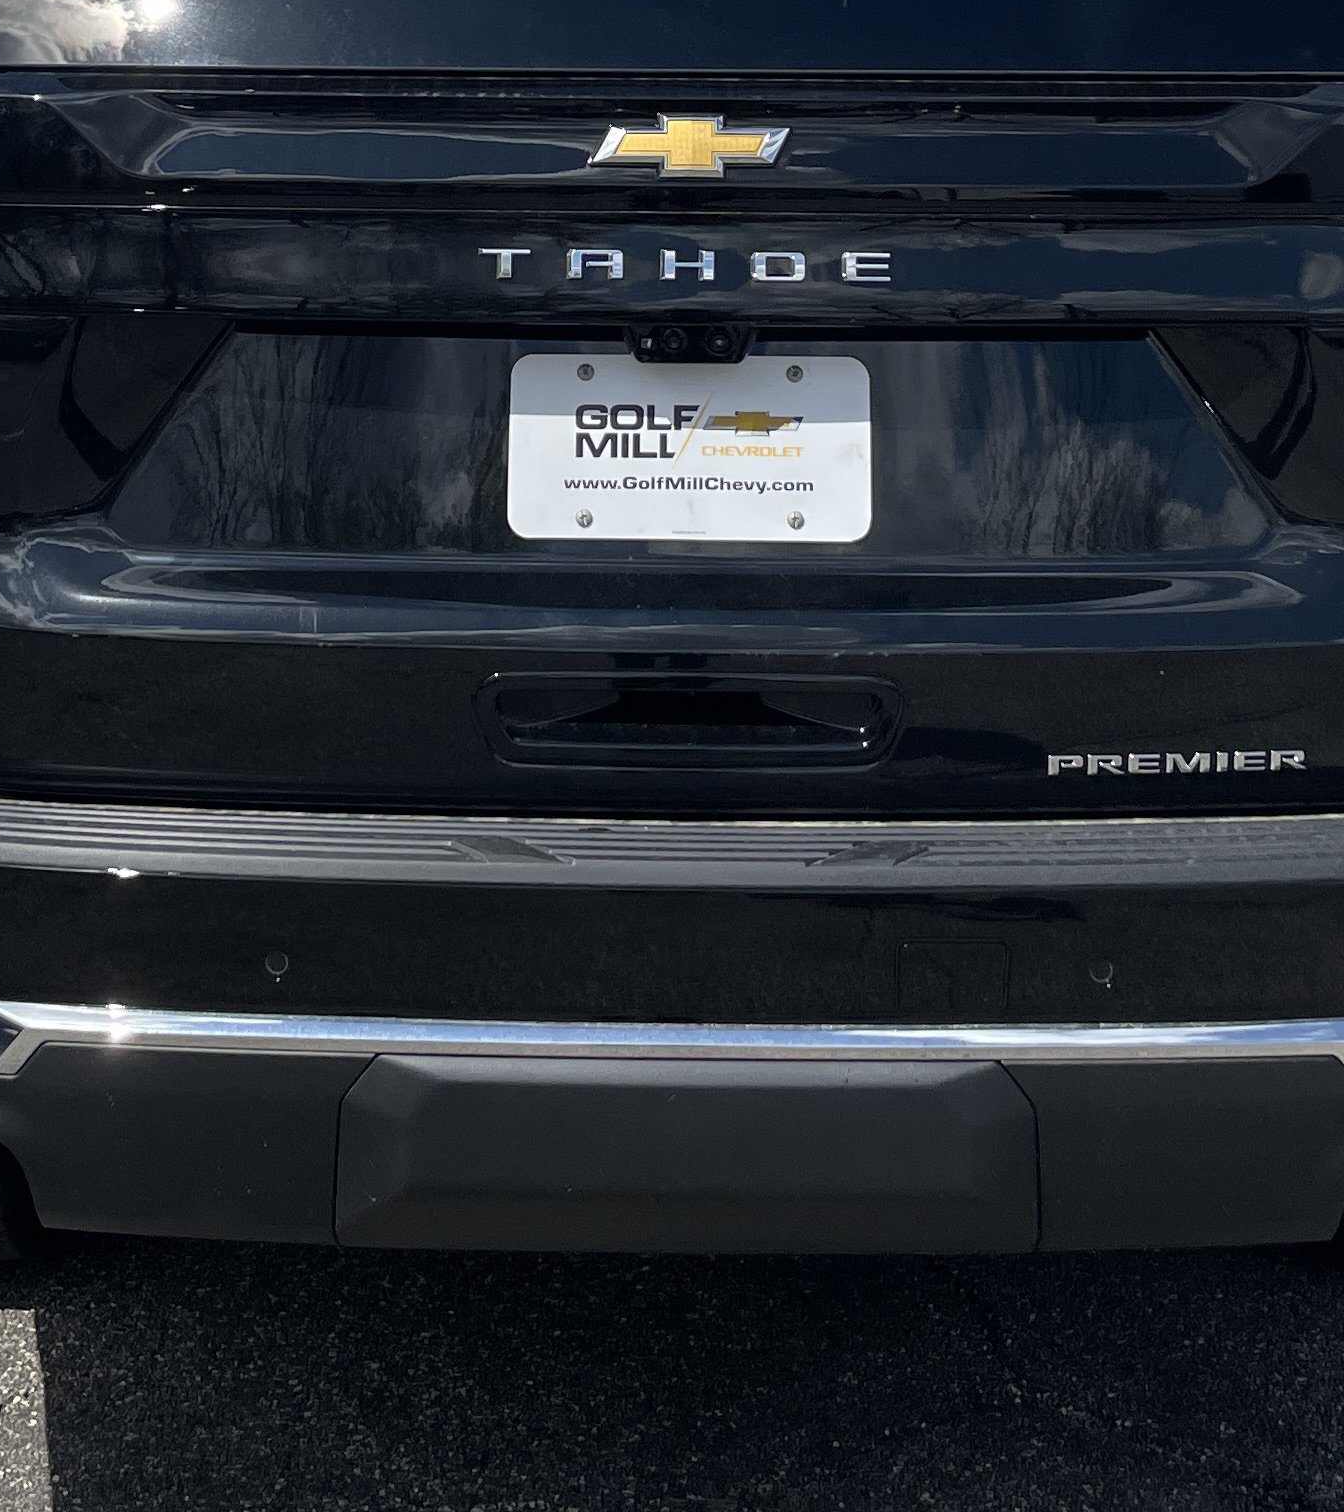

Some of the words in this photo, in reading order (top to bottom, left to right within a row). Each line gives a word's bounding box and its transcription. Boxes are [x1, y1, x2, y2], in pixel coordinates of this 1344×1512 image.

[478, 247, 892, 282] TAHOE
[575, 403, 700, 431] GOLF
[575, 431, 676, 459] MILL
[701, 445, 804, 458] CHEVROLET
[563, 476, 814, 495] www.GolfMillChevy.com
[1047, 749, 1307, 776] PREMIER
